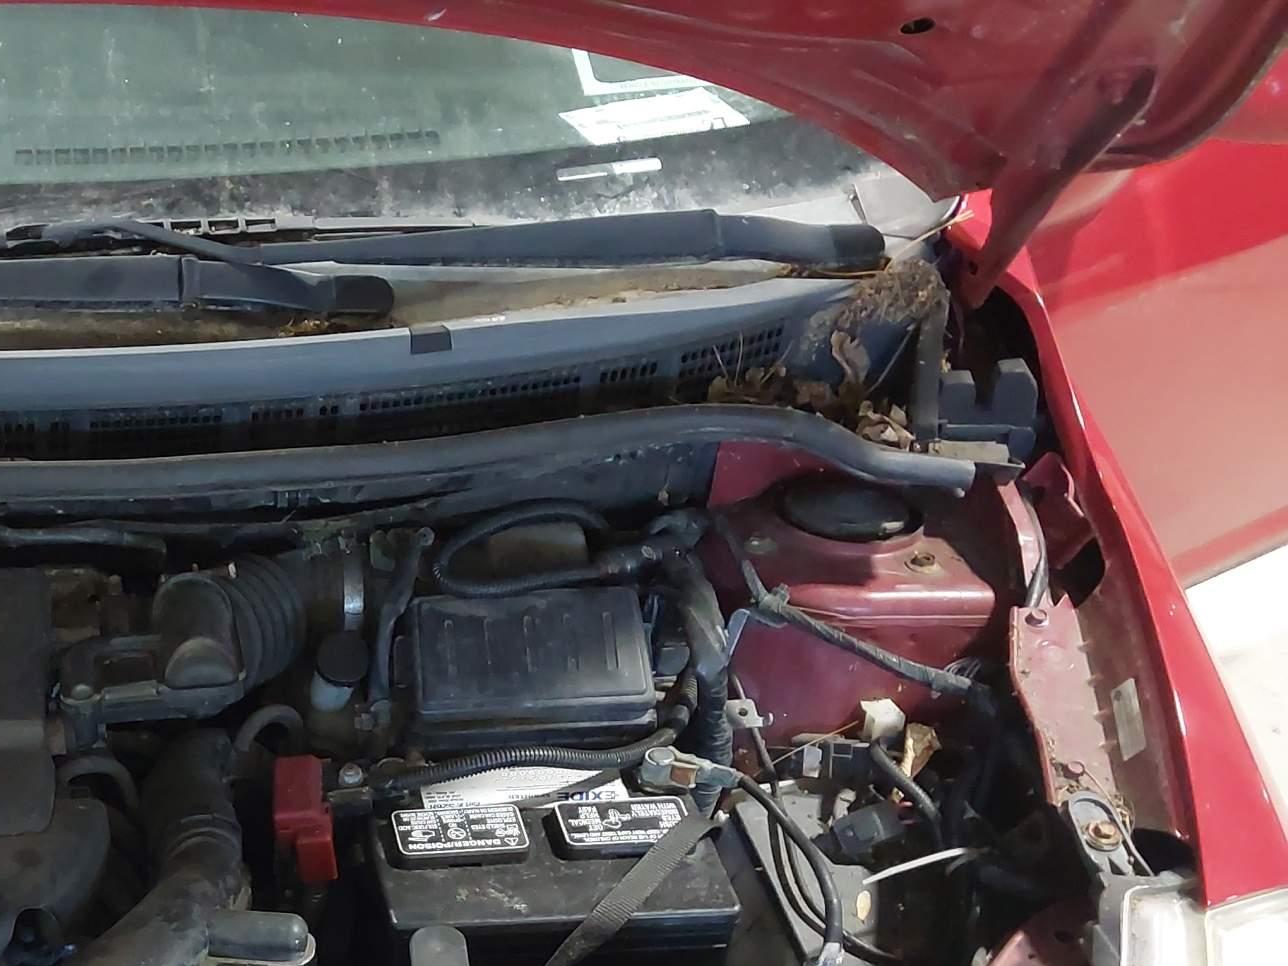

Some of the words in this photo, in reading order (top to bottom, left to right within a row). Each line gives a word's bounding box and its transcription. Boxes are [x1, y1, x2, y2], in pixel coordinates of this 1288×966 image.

[557, 790, 615, 802] EXIDE
[630, 803, 657, 811] WATER
[568, 818, 602, 826] MEDICAL
[408, 838, 502, 850] DANGER/POISON
